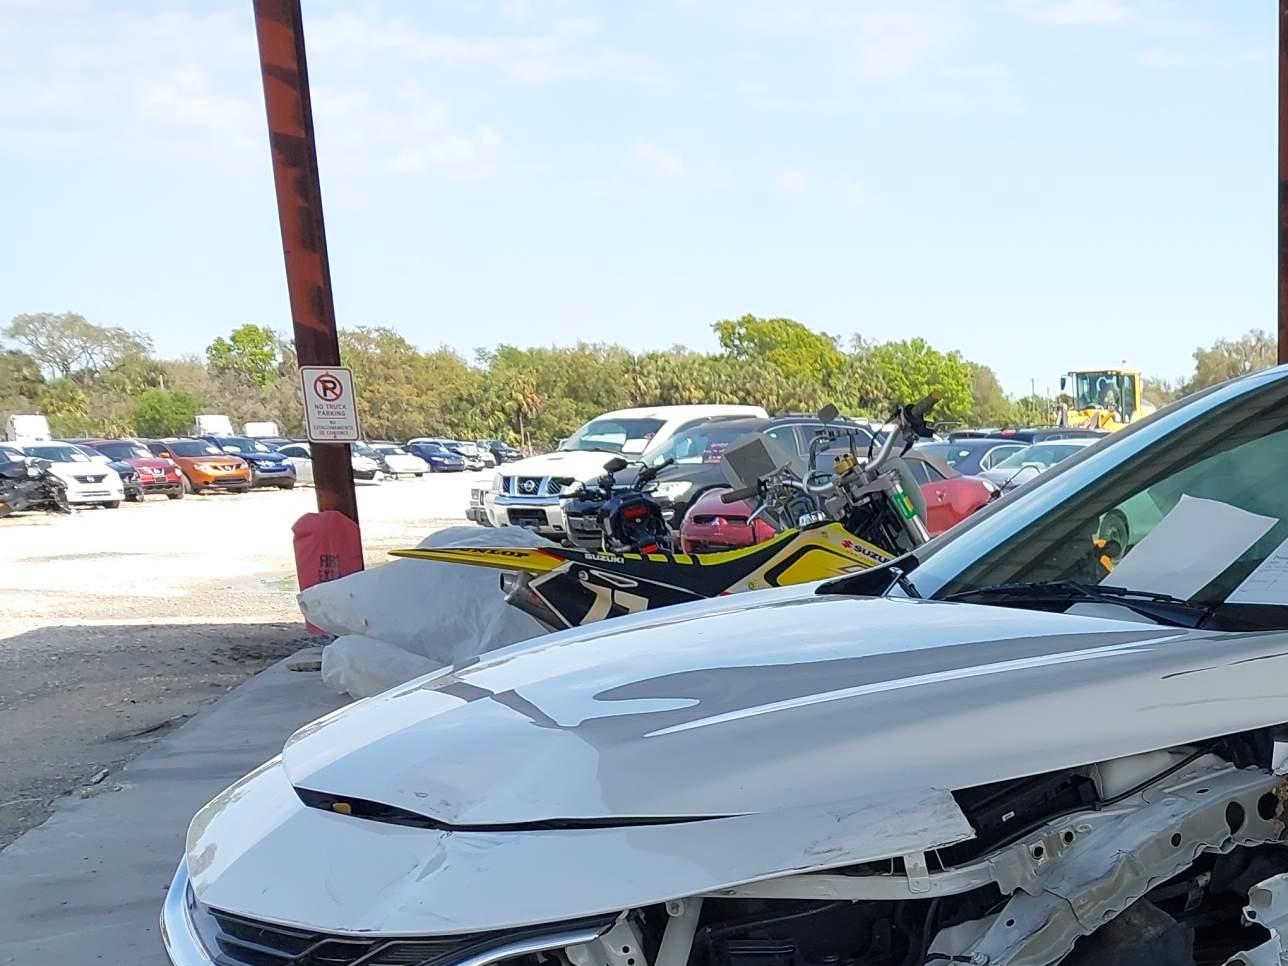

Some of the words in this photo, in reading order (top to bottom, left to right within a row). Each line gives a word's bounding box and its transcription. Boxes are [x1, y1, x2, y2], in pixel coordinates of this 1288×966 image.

[459, 548, 530, 558] UNLOP
[584, 553, 625, 565] SUZUKI
[854, 545, 891, 563] SUZU
